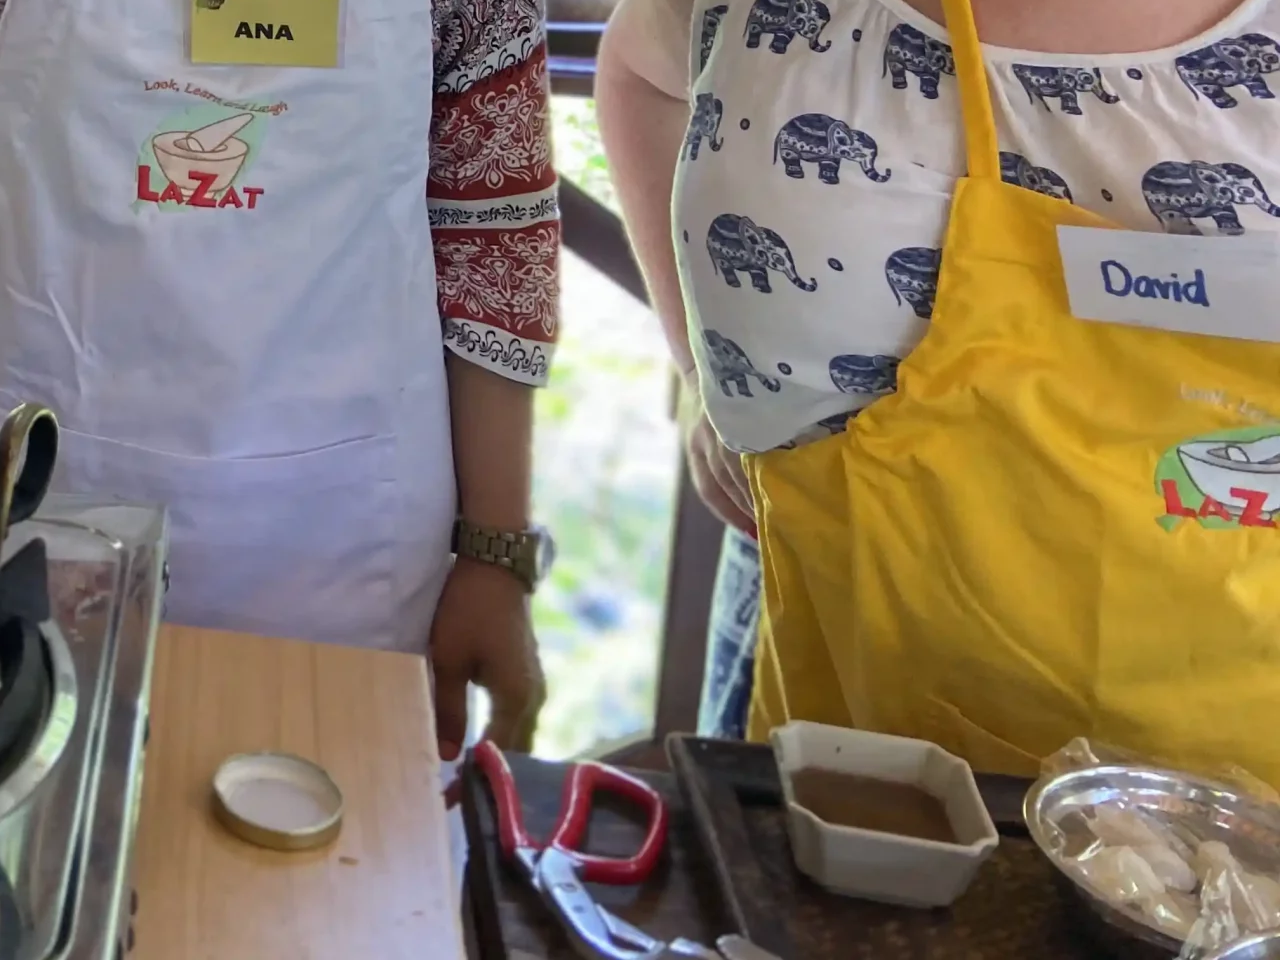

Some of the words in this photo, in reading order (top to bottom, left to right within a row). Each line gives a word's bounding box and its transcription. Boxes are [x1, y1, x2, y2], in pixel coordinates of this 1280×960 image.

[233, 21, 295, 41] ANA
[143, 78, 180, 92] Look,
[184, 82, 223, 106] Learn
[137, 164, 265, 209] LAZAT
[1100, 259, 1210, 308] David
[1160, 478, 1280, 529] LAZ
